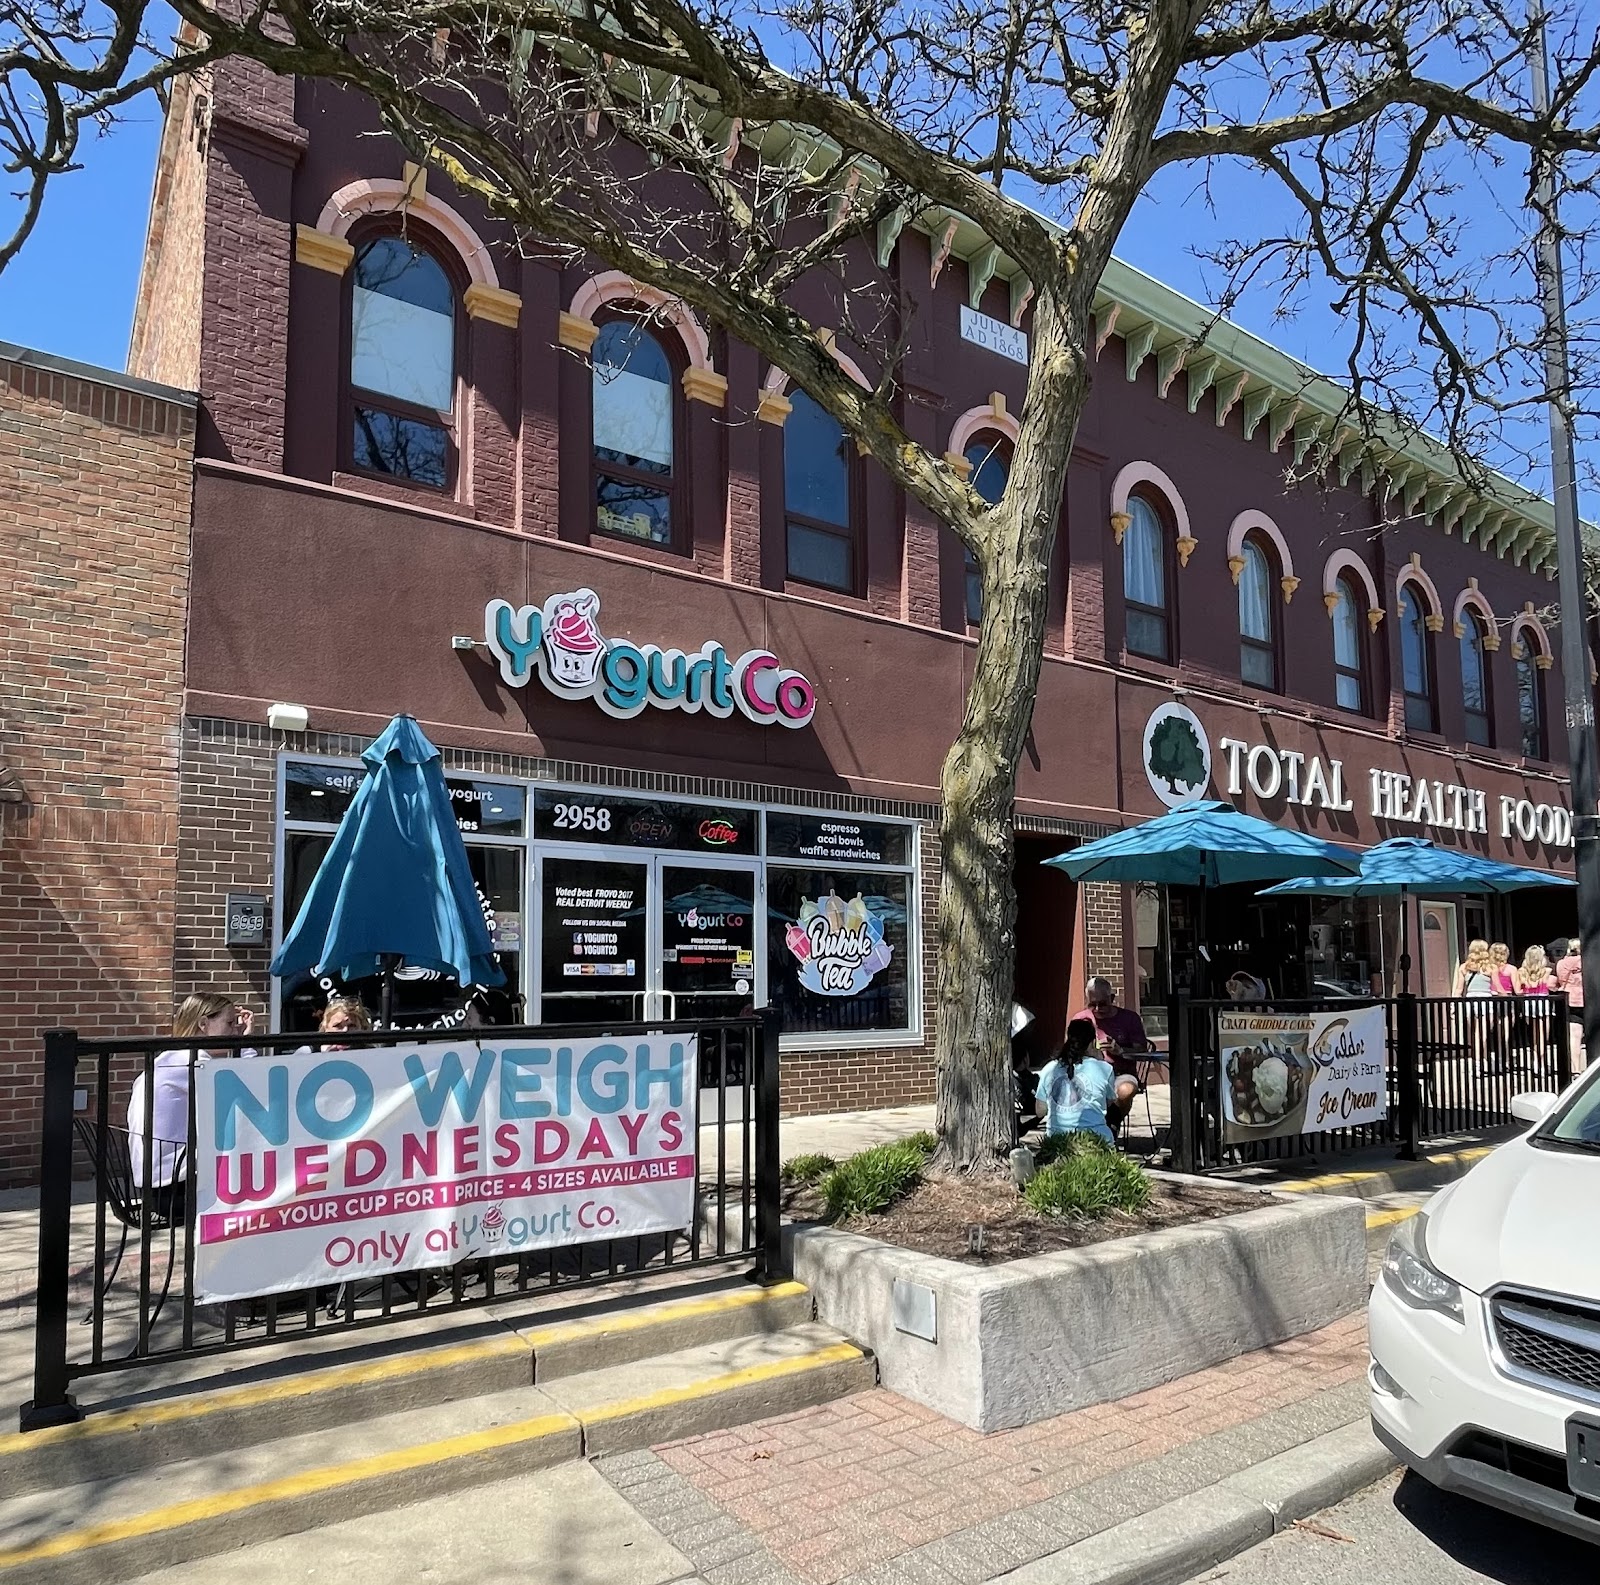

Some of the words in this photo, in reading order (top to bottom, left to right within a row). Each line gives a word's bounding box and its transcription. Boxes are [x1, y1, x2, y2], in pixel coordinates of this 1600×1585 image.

[970, 313, 1005, 337] JULY
[1012, 331, 1019, 344] 4
[993, 336, 1024, 361] 1868
[325, 775, 355, 788] self
[448, 788, 494, 803] yogurt
[1220, 737, 1354, 812] TOTAL
[1369, 768, 1488, 834] HEALTH
[1500, 795, 1576, 848] FOOD
[553, 803, 612, 832] 2958
[630, 820, 673, 838] OPEN
[698, 819, 739, 843] Coffee
[820, 823, 860, 834] espresso
[816, 834, 837, 845] acai
[838, 835, 864, 847] bowls
[799, 845, 829, 857] waffle
[830, 847, 881, 860] sandwiches
[555, 887, 577, 897] Voted
[577, 887, 593, 898] best
[594, 889, 618, 899] FROYO
[618, 890, 634, 899] 2017
[555, 897, 575, 907] REAL
[575, 898, 605, 908] DETROIT
[605, 899, 633, 909] WEEKLY
[726, 914, 744, 927] Co
[583, 932, 618, 944] YOGURTCO
[807, 915, 872, 959] Bubble
[583, 944, 618, 955] YOGURTCO
[818, 956, 862, 991] Tea
[1221, 1018, 1249, 1030] CRAZY
[1249, 1018, 1289, 1030] GRIDDLE
[1289, 1019, 1316, 1031] CAKES
[213, 1060, 375, 1152] NO
[403, 1043, 684, 1127] WEIGH
[1316, 1091, 1339, 1124] Ice
[215, 1111, 684, 1205] WEDNESDAYS
[223, 1212, 271, 1236] FILL
[278, 1204, 339, 1227] YOUR
[345, 1193, 387, 1216] CUP
[393, 1186, 435, 1209] FOR
[439, 1186, 449, 1204] 1
[454, 1179, 504, 1202] PRICE
[521, 1177, 533, 1192] 4
[537, 1170, 586, 1191] SIZES
[590, 1160, 679, 1185] AVAILABLE
[324, 1231, 411, 1267] Only
[424, 1221, 459, 1253] at
